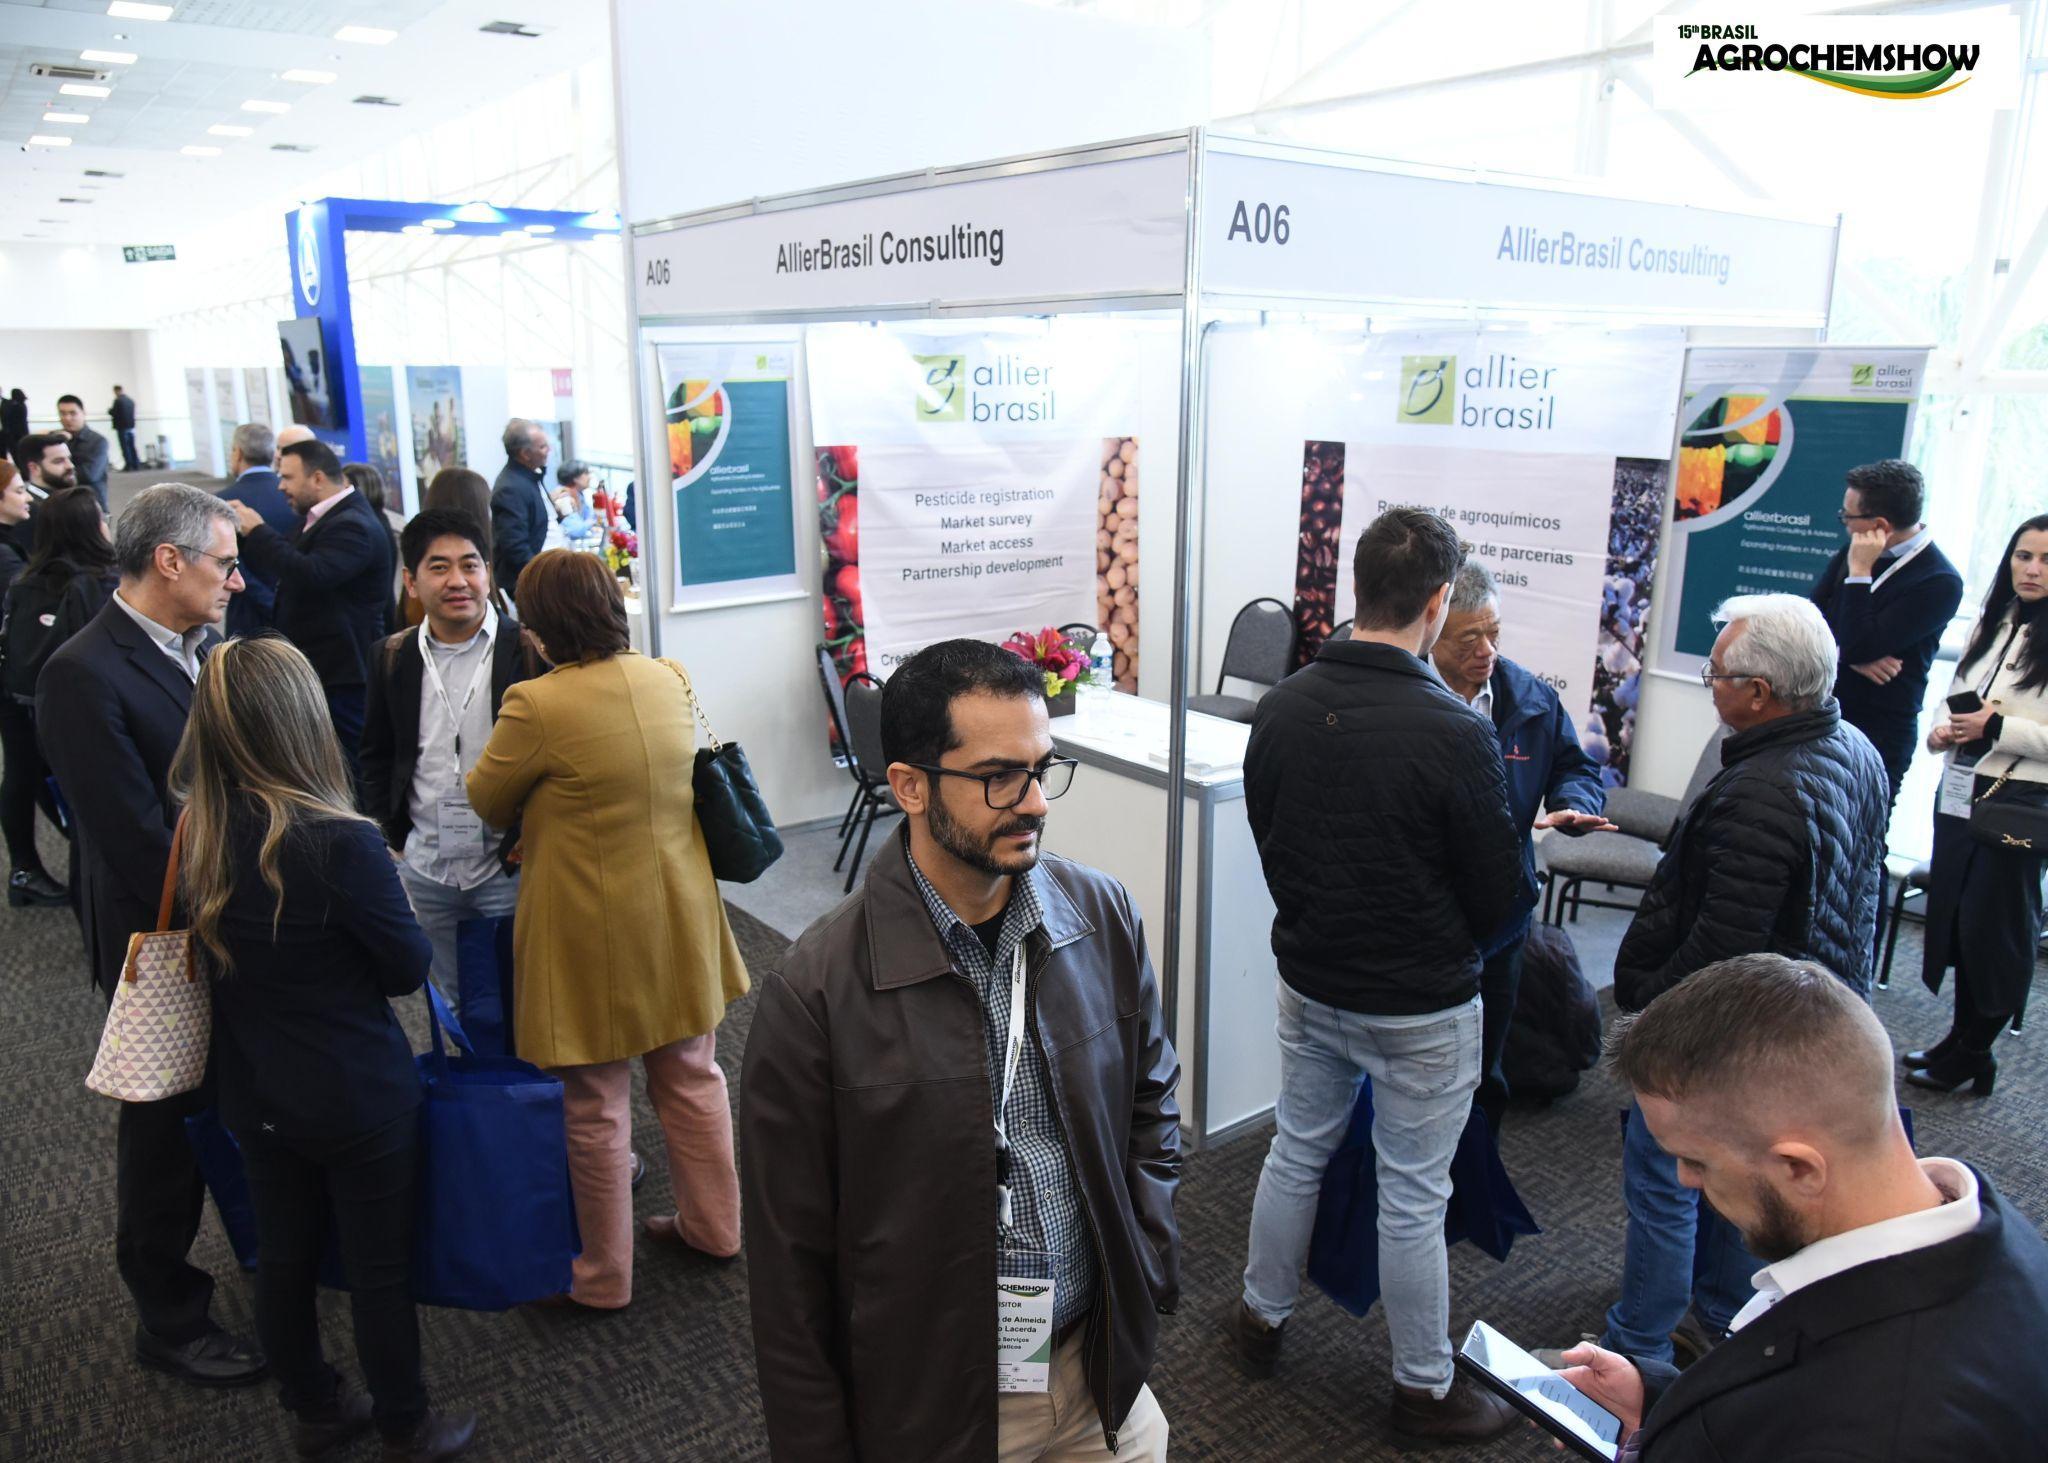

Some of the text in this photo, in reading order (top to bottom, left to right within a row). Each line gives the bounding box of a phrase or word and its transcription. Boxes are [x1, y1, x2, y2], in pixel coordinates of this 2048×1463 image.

[1228, 200, 1290, 245] A06
[776, 222, 1004, 274] AllierBrasil Consulting
[1497, 225, 1731, 286] AllierBrasil Consulting
[646, 259, 671, 286] A06
[974, 355, 1053, 386] allier
[1465, 354, 1557, 389] allier
[1875, 377, 1913, 388] brasil
[1877, 365, 1912, 376] allier
[973, 391, 1055, 422] brasil
[1461, 394, 1554, 430] brasil
[915, 488, 1055, 507] Pesticide registration
[941, 514, 1032, 530] Market survey
[1440, 506, 1456, 519] de
[1460, 511, 1561, 531] agroquímicos
[1743, 510, 1811, 526] allierbrasil
[941, 537, 1034, 555] Market access
[1480, 542, 1497, 557] de
[1501, 547, 1573, 565] parcerias
[902, 555, 1064, 581] Partnership development
[1494, 570, 1528, 587] ciais
